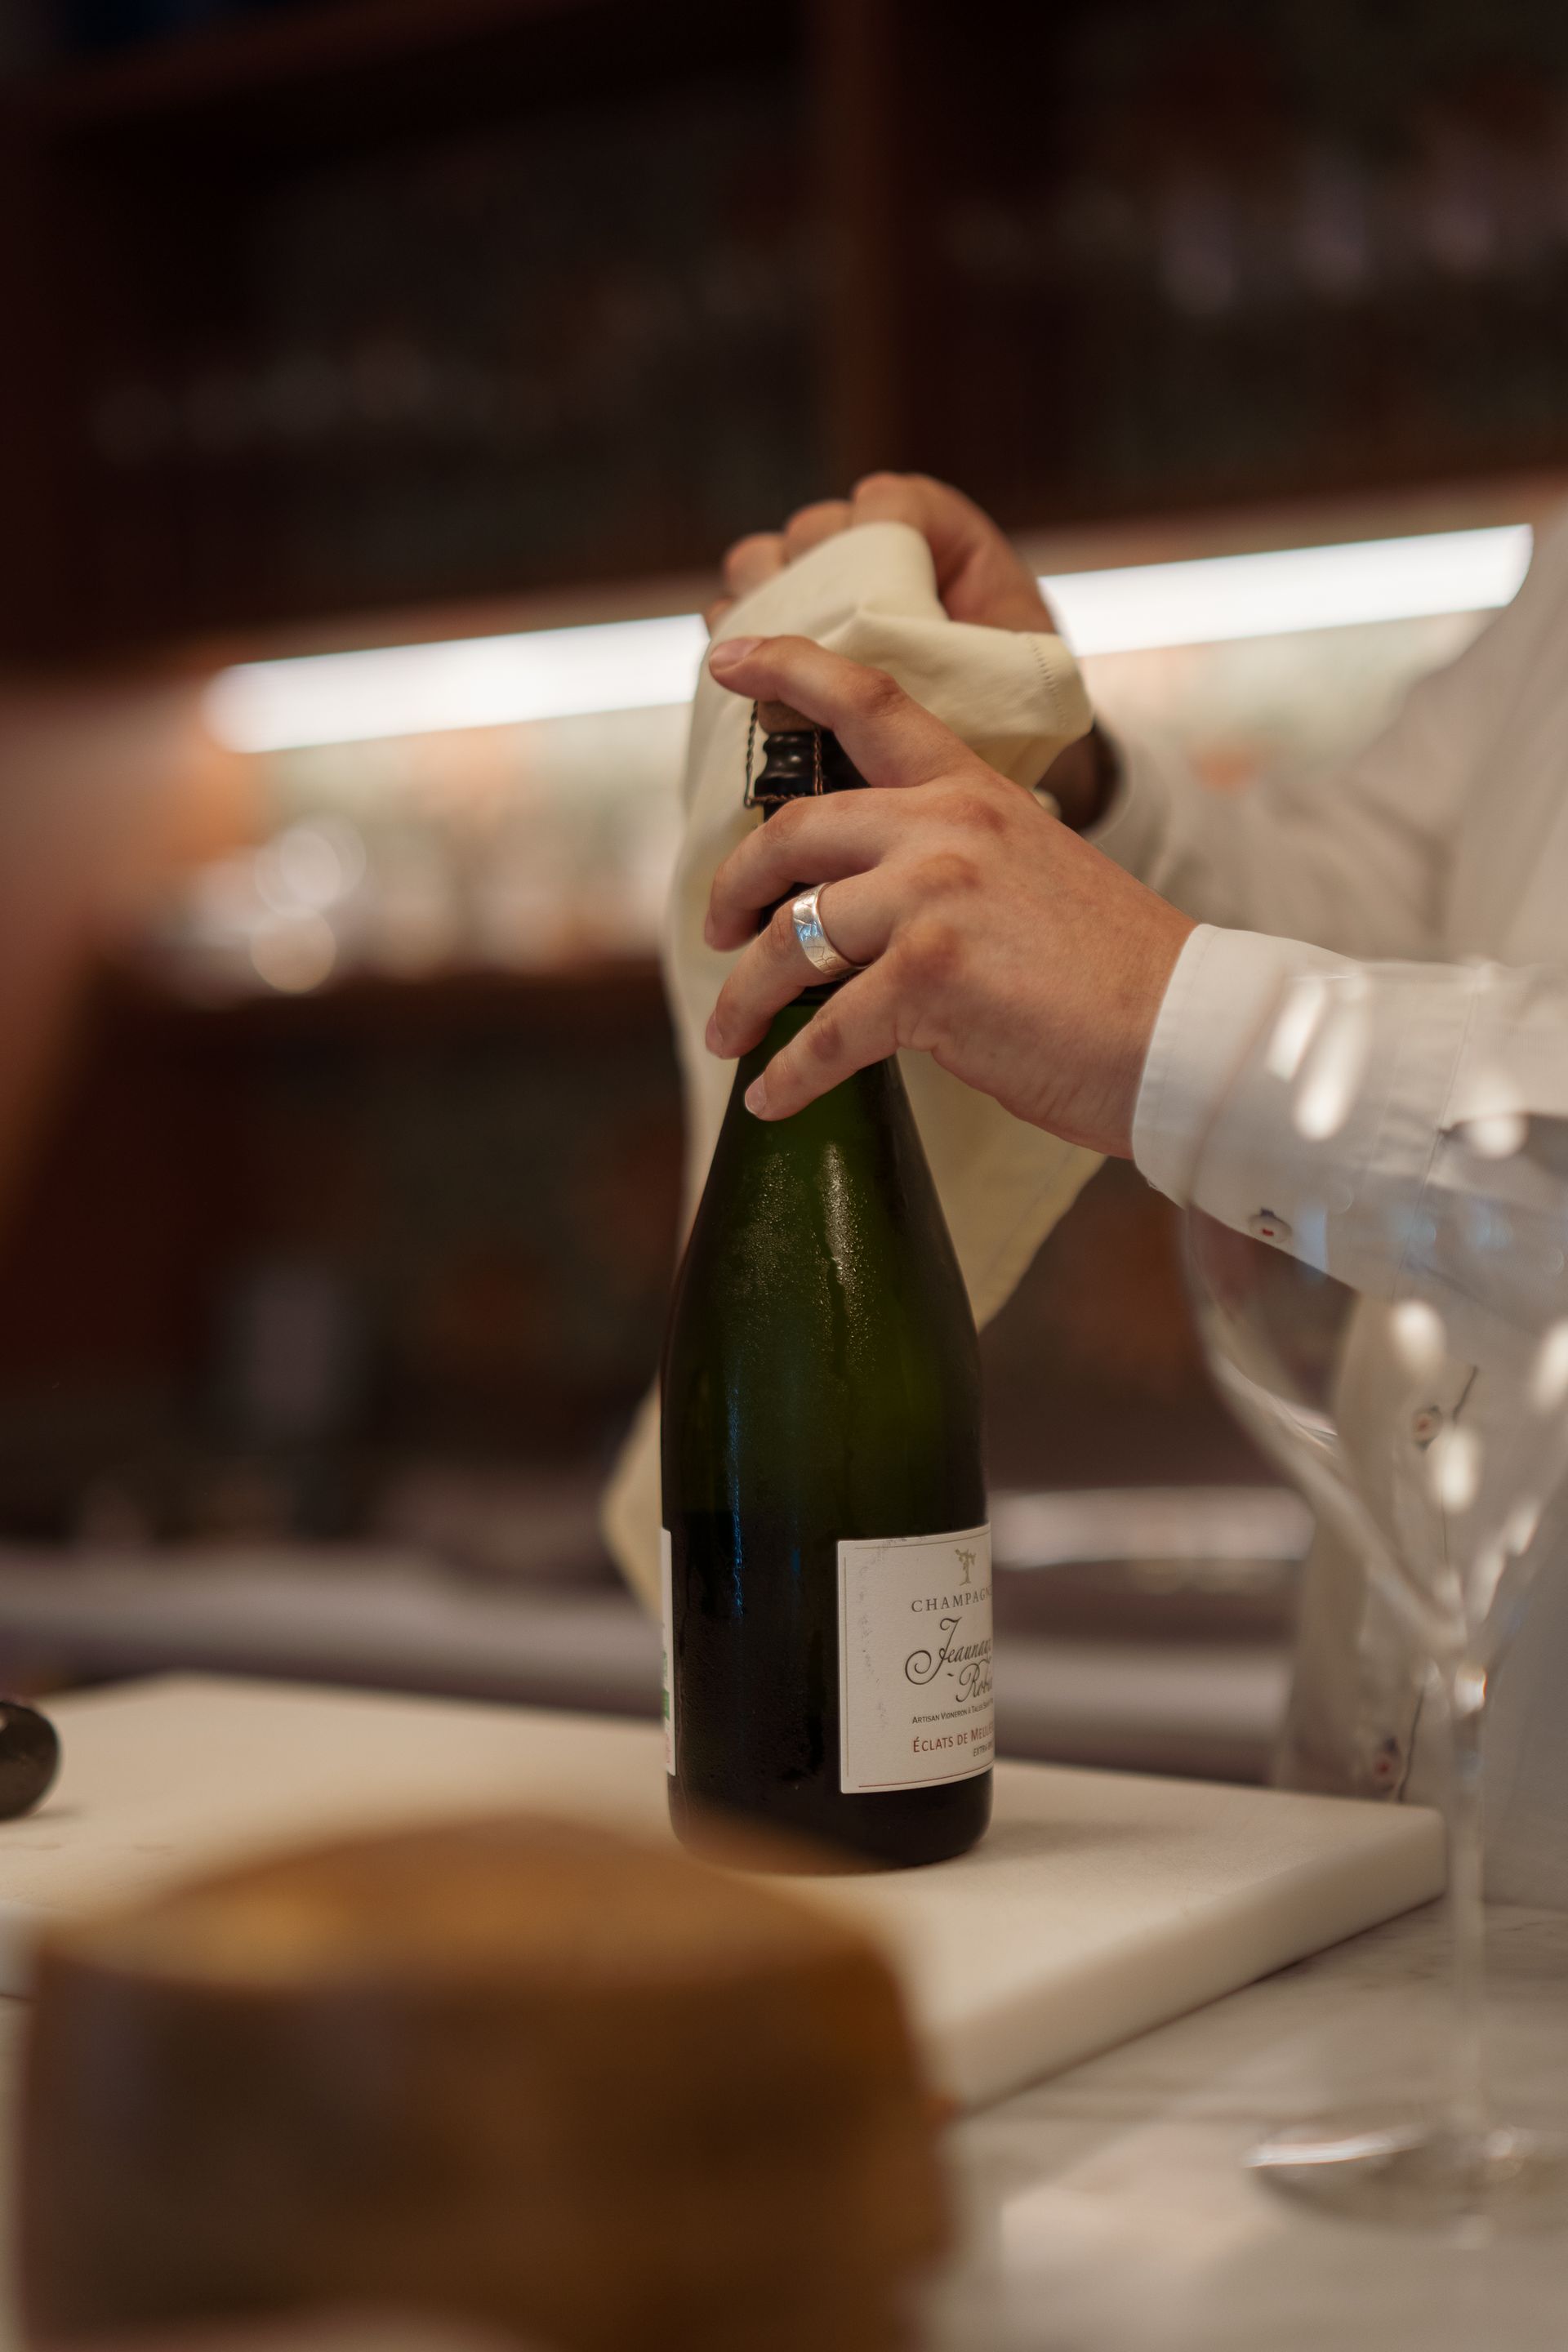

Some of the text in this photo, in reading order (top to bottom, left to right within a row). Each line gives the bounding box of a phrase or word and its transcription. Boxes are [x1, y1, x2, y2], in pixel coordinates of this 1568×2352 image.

[912, 1714, 940, 1724] ARTISAN
[941, 1709, 968, 1720] VIGNERON
[913, 1736, 954, 1753] ÉCLATS
[957, 1733, 968, 1746] DE
